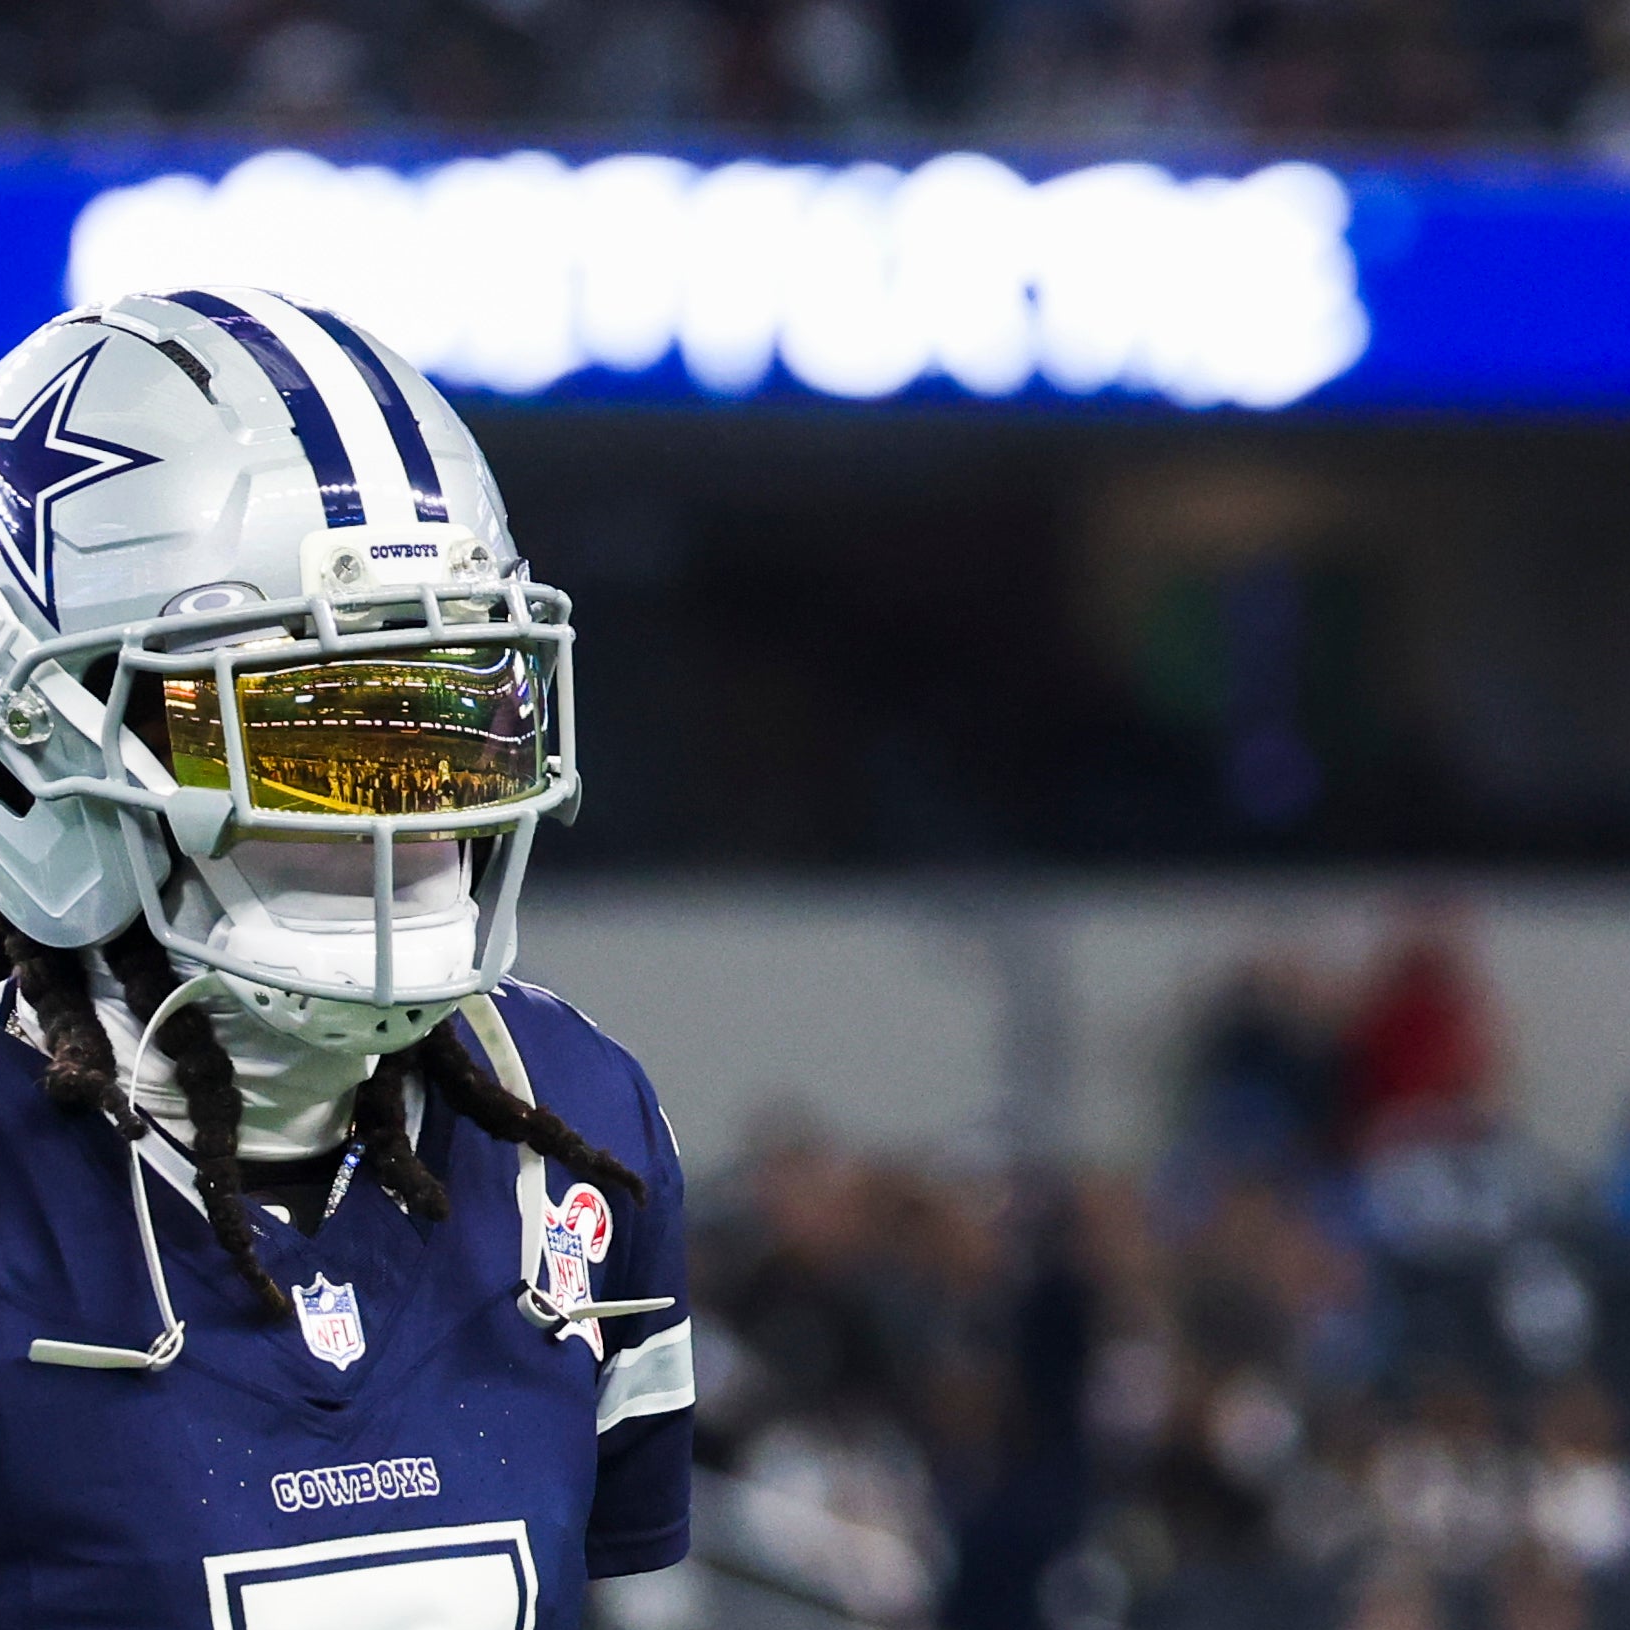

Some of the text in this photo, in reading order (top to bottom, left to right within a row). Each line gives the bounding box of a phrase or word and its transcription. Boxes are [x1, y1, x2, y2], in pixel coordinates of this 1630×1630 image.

[370, 543, 439, 559] COWBOYS
[555, 1255, 584, 1293] NFL
[316, 1316, 356, 1349] NFL
[271, 1457, 441, 1512] COWBOYS
